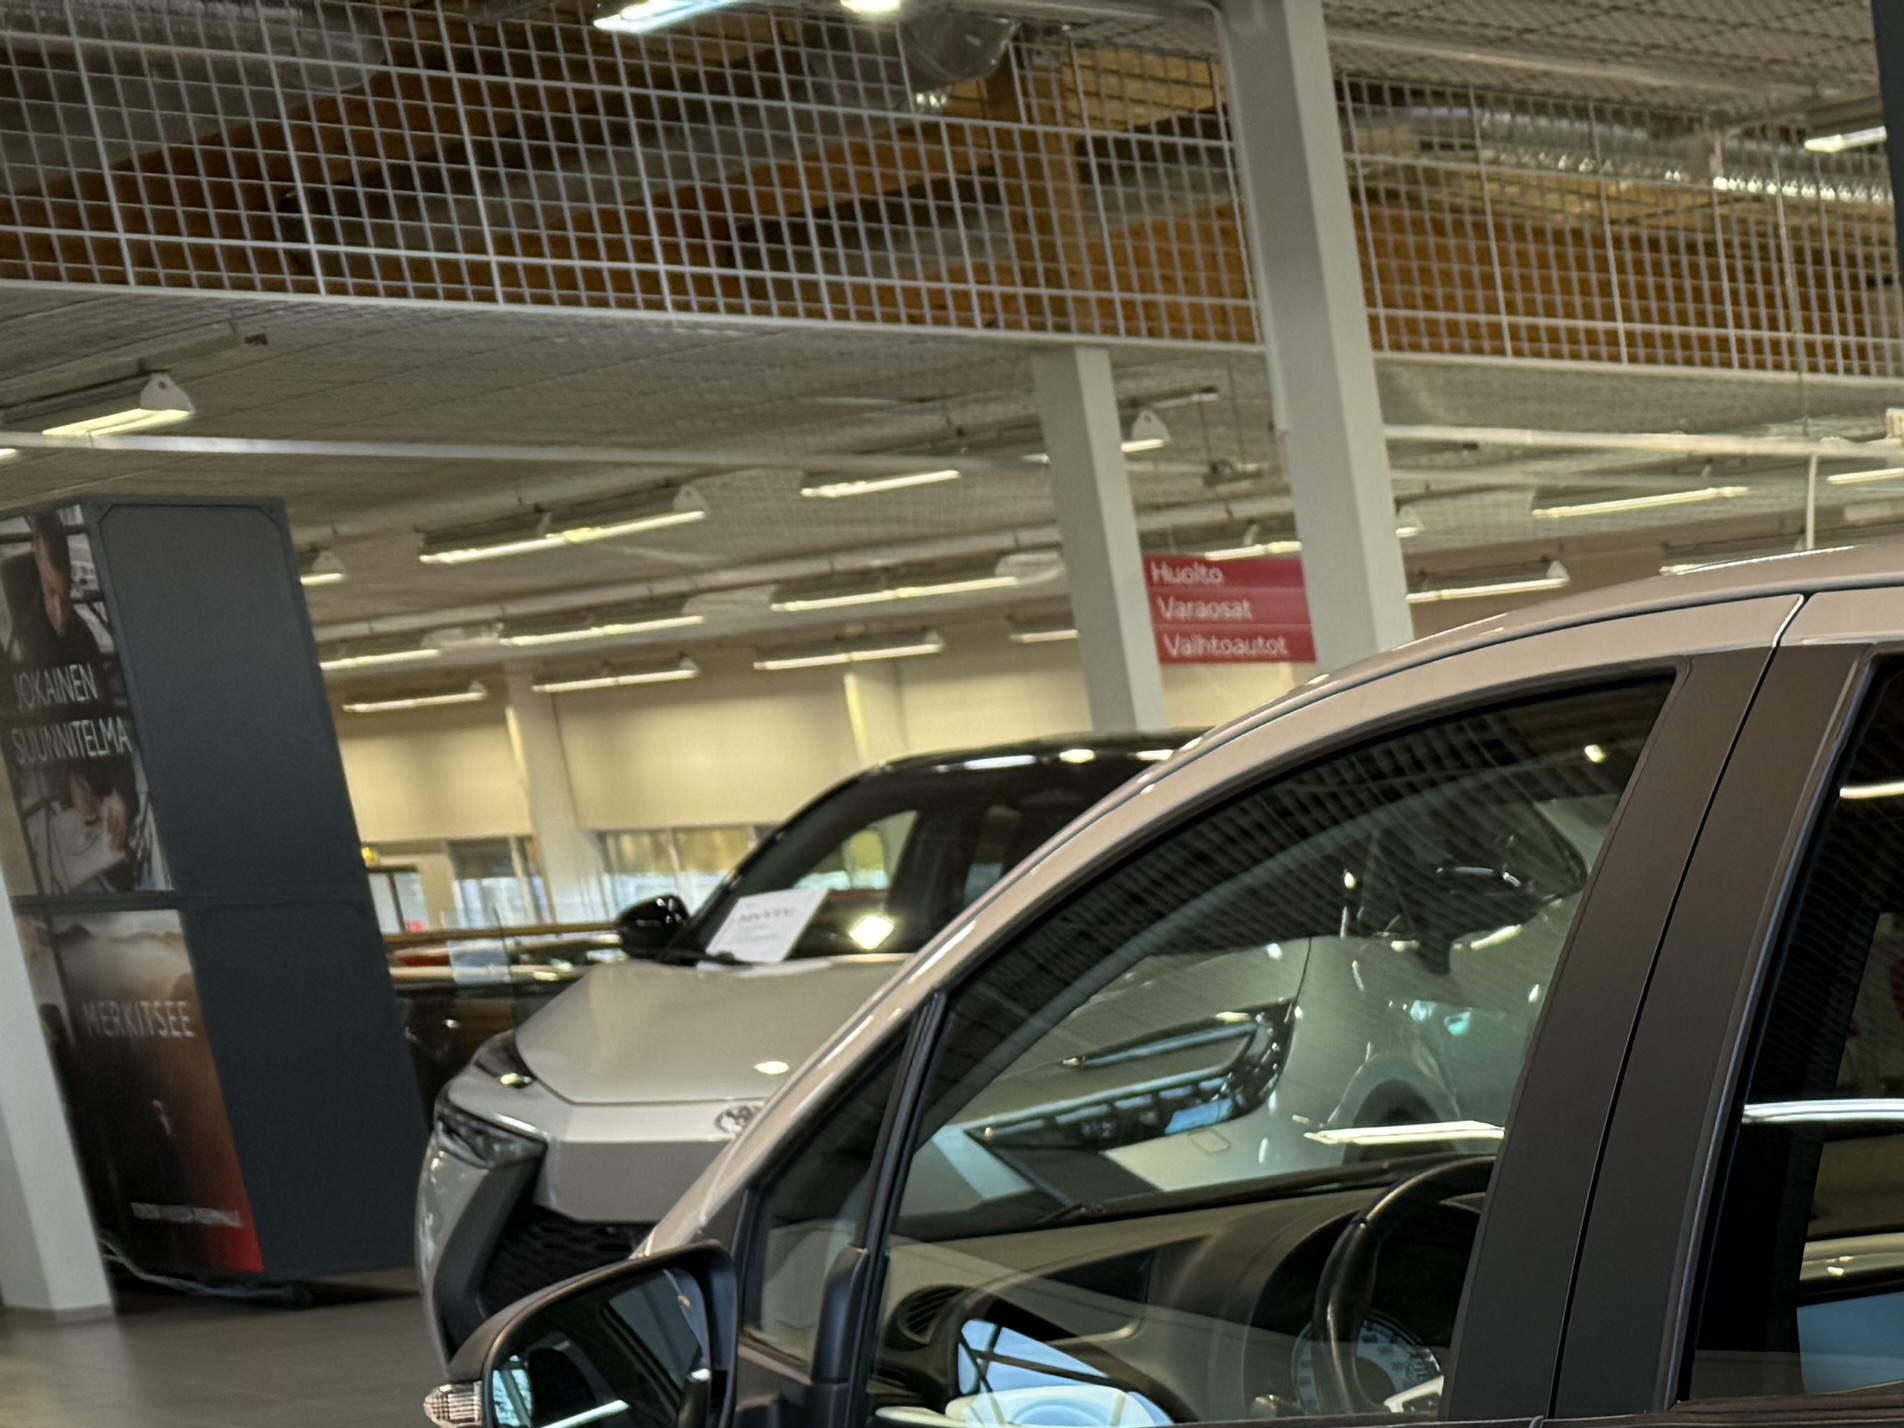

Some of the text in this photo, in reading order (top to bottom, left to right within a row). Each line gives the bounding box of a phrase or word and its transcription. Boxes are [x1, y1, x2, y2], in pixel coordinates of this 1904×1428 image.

[1151, 560, 1225, 585] Huolto
[1157, 595, 1254, 621] Varaosat
[1163, 632, 1289, 659] Vaihtoautot
[14, 662, 99, 710] JOKAINEN
[11, 715, 133, 764] SUUNNITELMA
[82, 1000, 196, 1039] MERKITSEE
